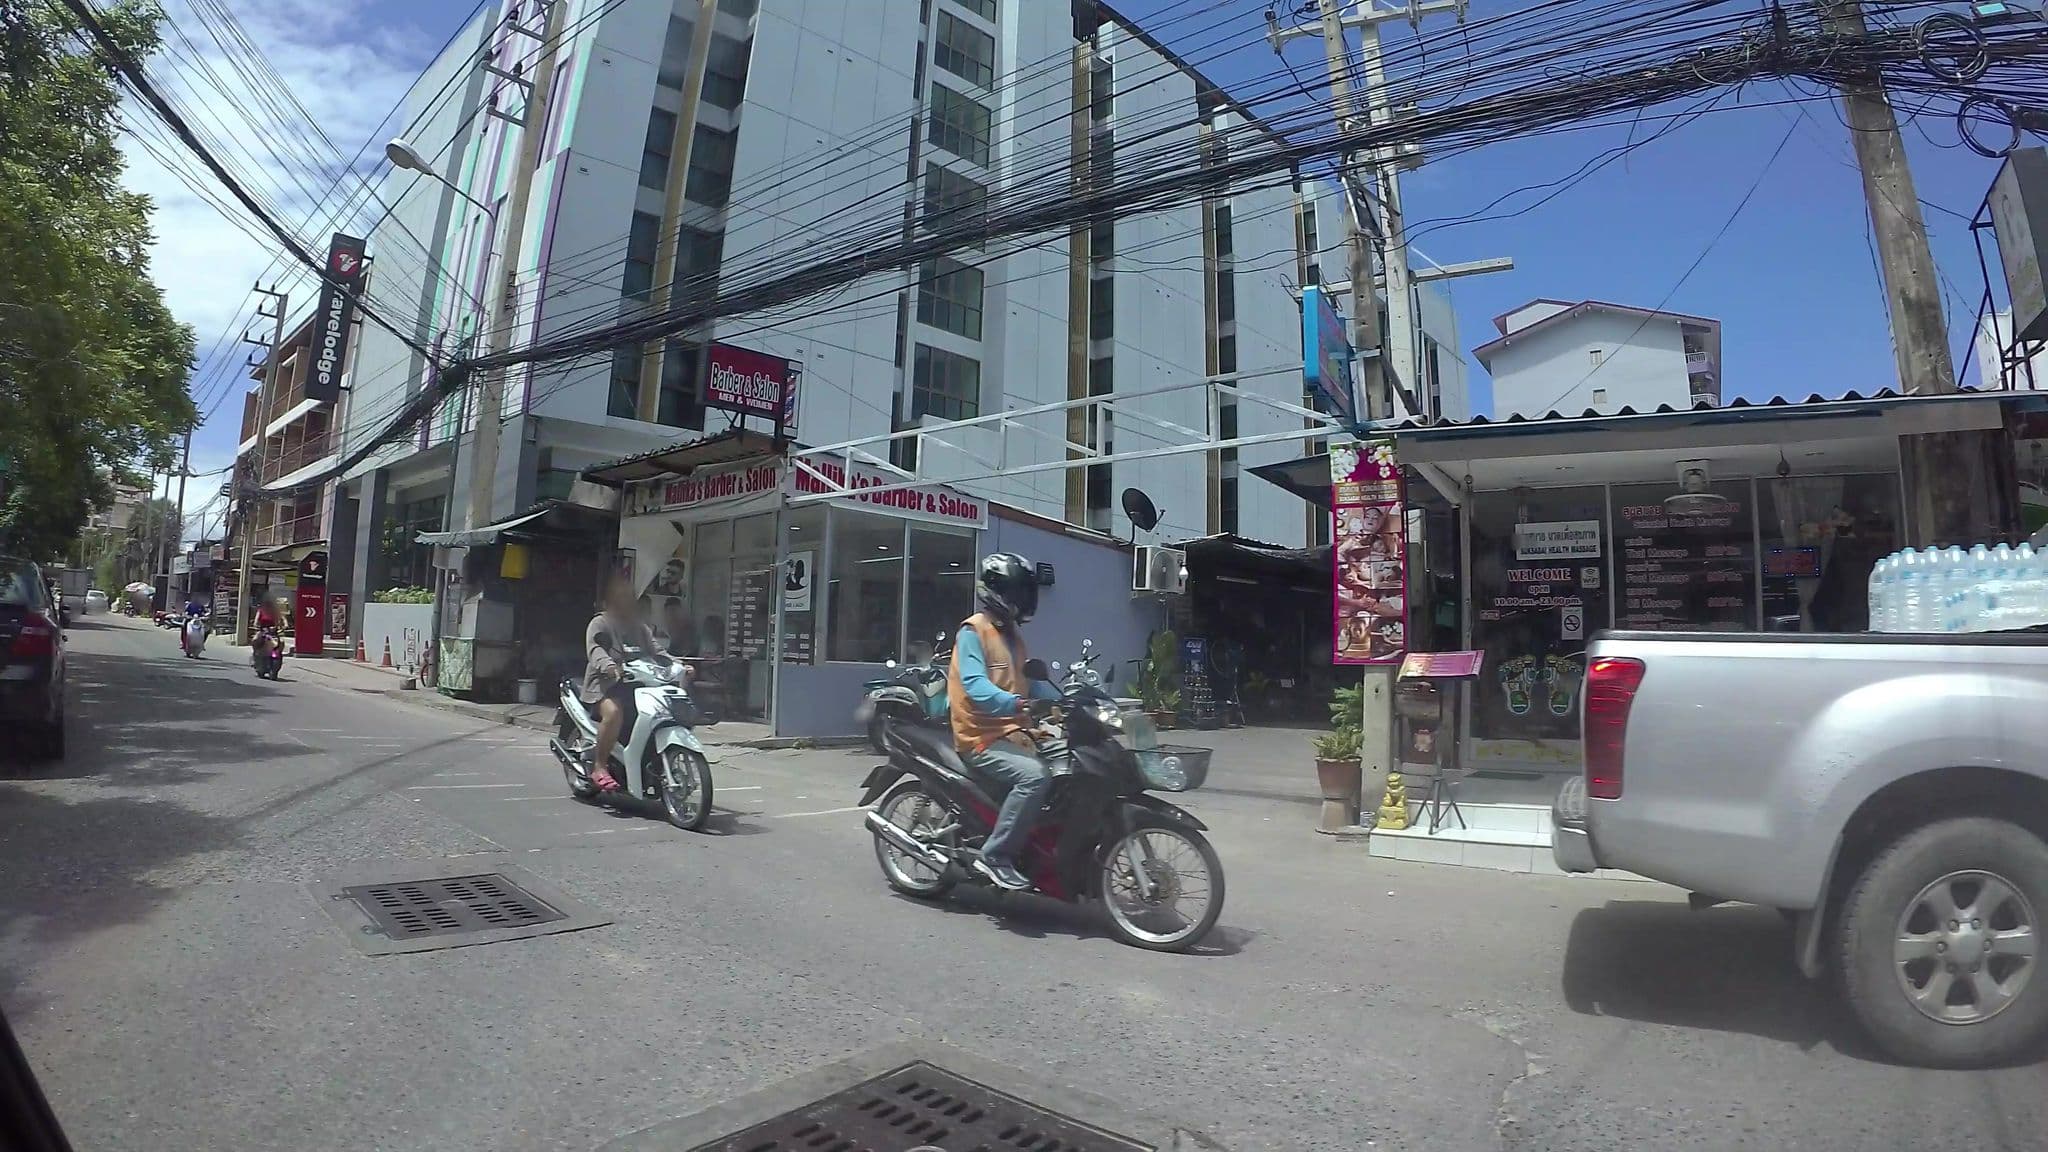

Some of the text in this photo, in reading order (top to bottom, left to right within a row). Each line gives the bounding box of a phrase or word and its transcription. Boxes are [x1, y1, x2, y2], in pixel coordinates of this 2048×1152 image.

[317, 282, 350, 385] Travelodge
[710, 362, 780, 403] Barber & Salon
[718, 392, 773, 410] MEN & WOMEN
[704, 470, 737, 499] Barber
[738, 478, 744, 493] &
[746, 465, 776, 492] Salon
[926, 494, 936, 512] &
[939, 493, 978, 519] Salon
[1507, 568, 1572, 582] WELCOME
[1528, 585, 1551, 595] open
